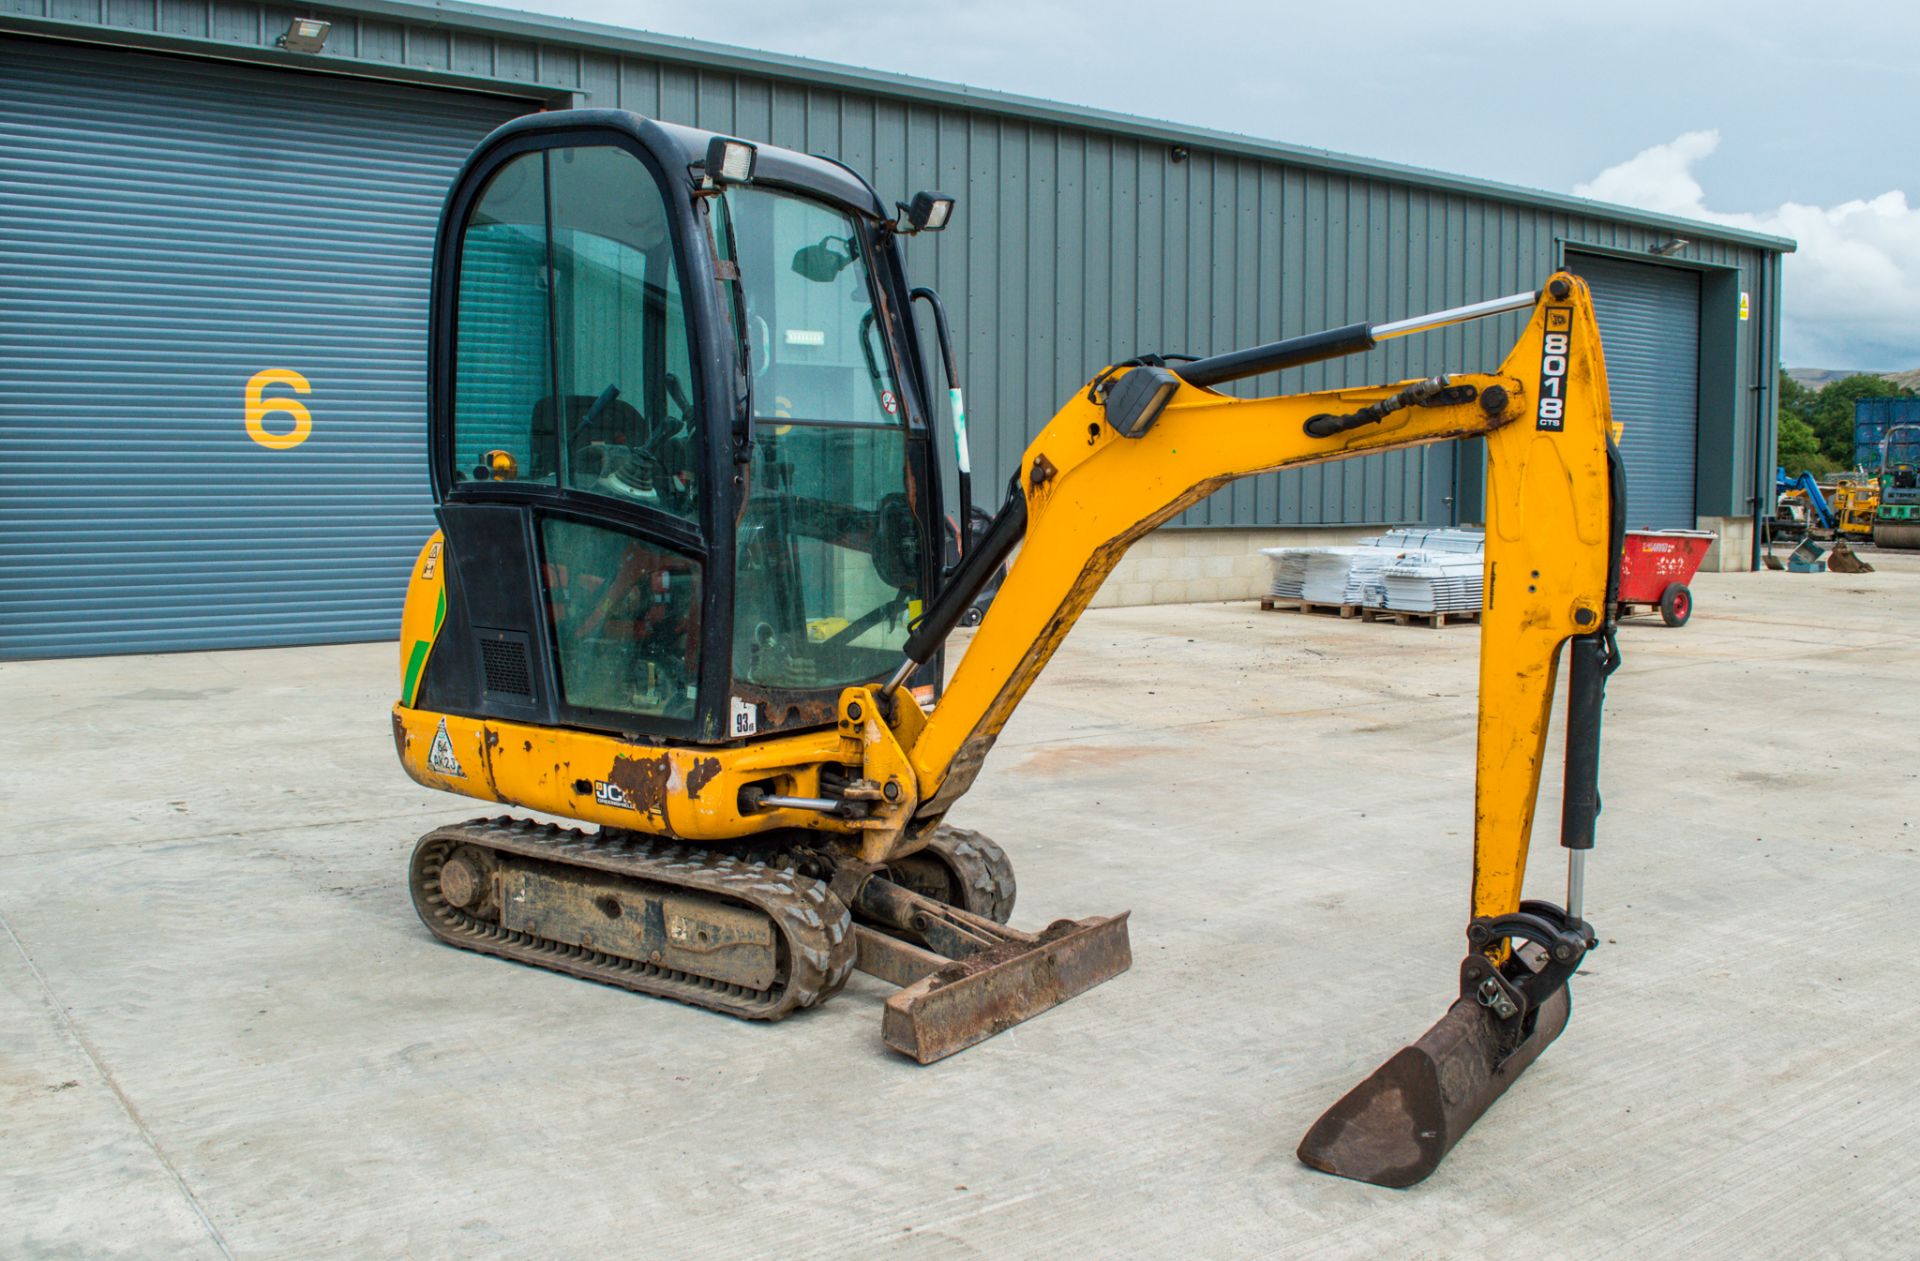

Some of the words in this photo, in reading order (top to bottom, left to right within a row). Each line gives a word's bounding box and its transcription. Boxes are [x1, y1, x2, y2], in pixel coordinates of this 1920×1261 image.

[1539, 334, 1568, 419] 8018
[245, 368, 312, 450] 6
[737, 713, 749, 732] 93
[596, 783, 627, 802] JC
